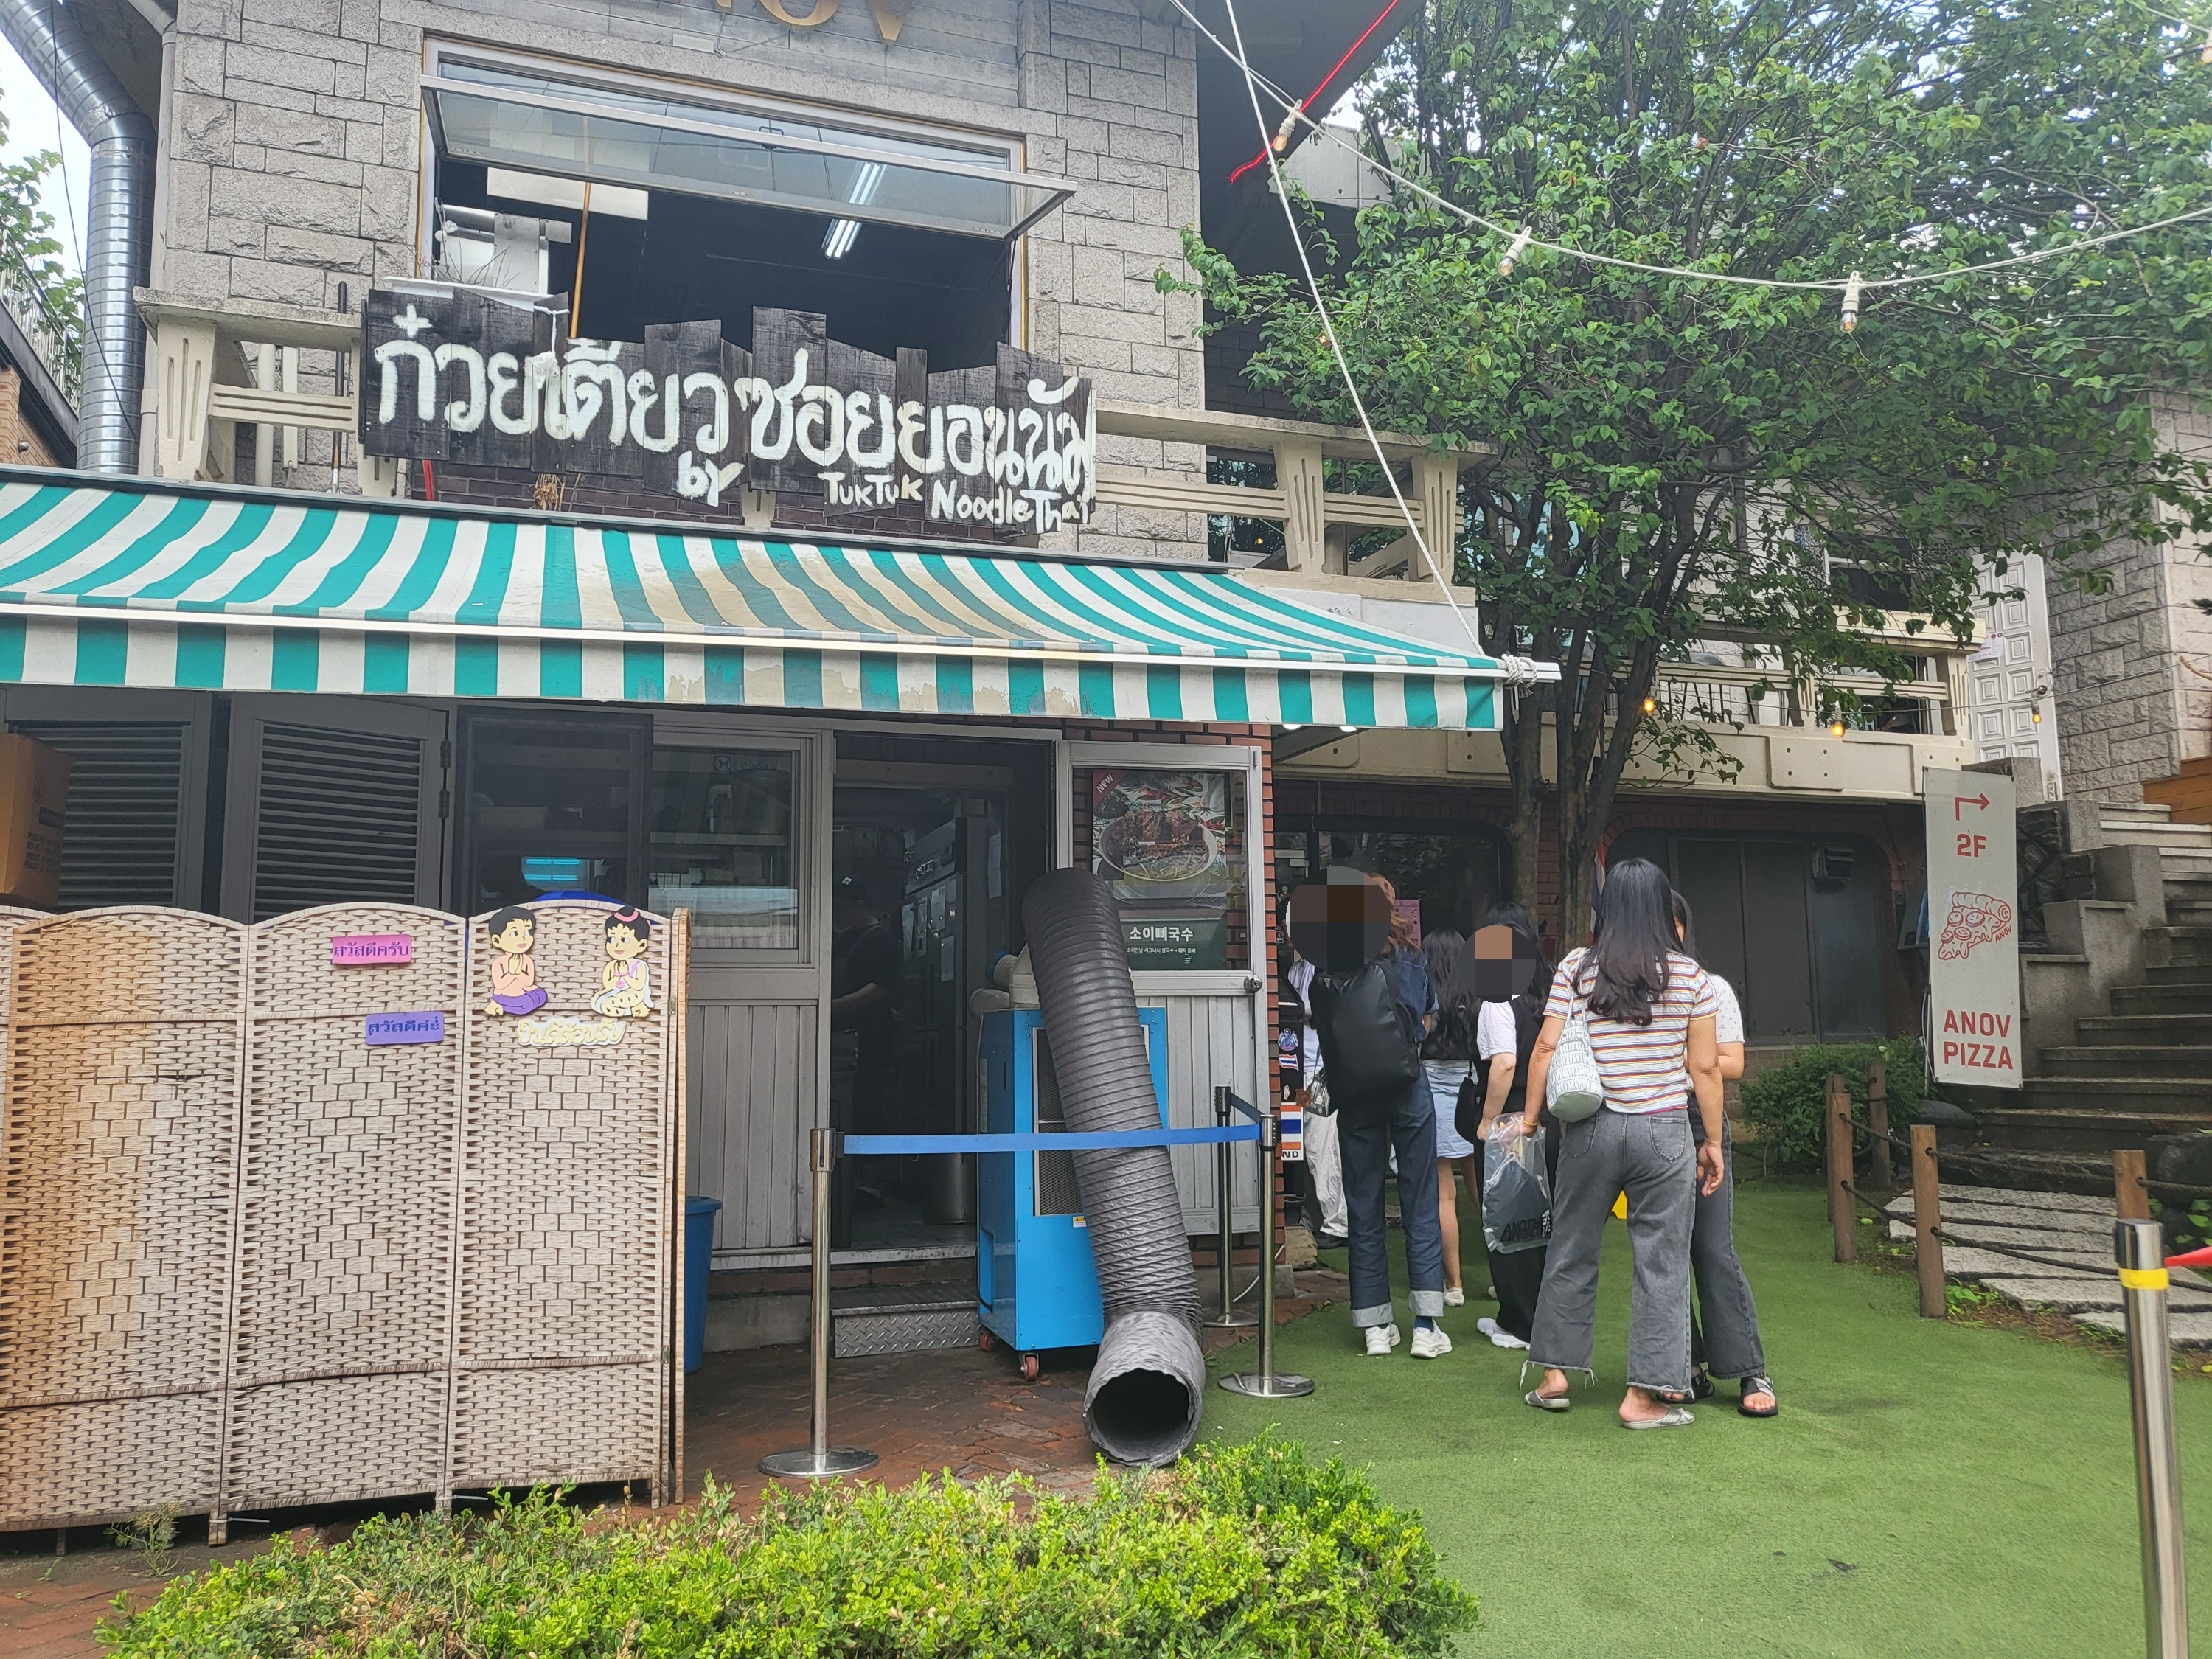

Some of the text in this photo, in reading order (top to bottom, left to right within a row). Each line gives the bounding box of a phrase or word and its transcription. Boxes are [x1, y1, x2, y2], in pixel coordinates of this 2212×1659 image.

[1096, 773, 1114, 793] NEW
[1956, 834, 1987, 858] 2F
[1129, 926, 1194, 942] 소이뼈국수
[1994, 925, 2012, 943] ANOV
[334, 942, 409, 957] สวัสดีครับ
[1943, 1009, 2011, 1037] ANOV
[1943, 1041, 2014, 1070] PIZZA
